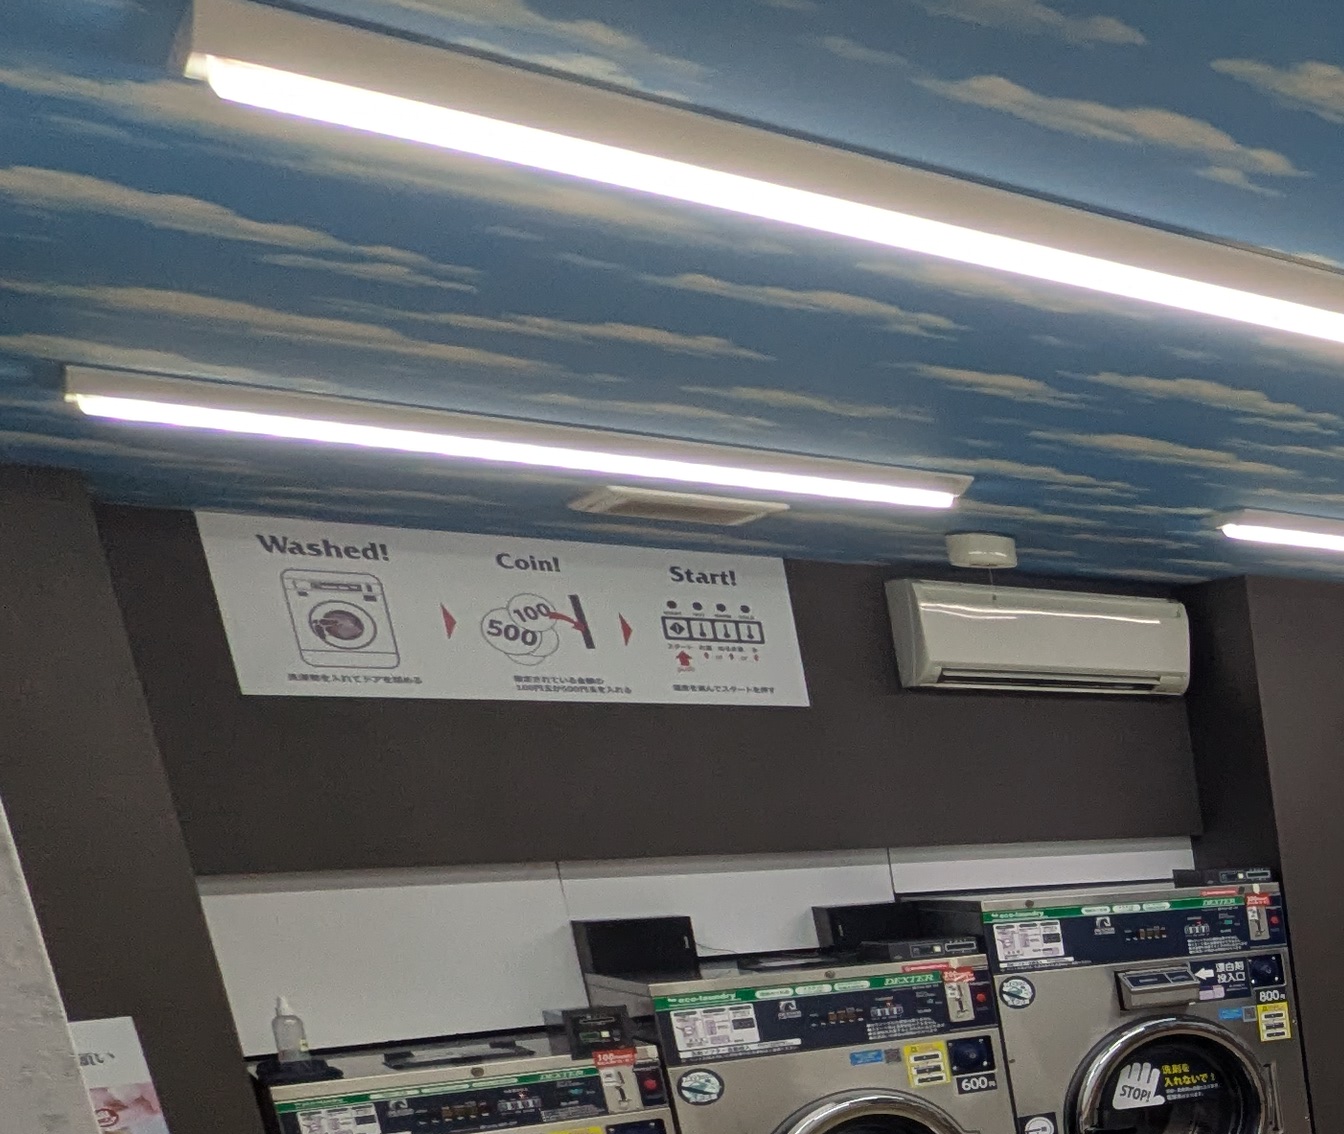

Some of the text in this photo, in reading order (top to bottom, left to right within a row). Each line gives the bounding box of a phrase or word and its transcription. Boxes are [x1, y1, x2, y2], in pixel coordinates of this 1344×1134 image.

[256, 534, 389, 561] Washed!
[496, 552, 561, 574] Coin!
[669, 565, 738, 586] Start!
[514, 603, 551, 623] 100
[487, 619, 538, 647] 500
[884, 973, 935, 986] DEXTER
[1162, 1063, 1190, 1074] 洗剤を
[961, 1077, 996, 1092] 600円
[1164, 1072, 1216, 1087] 入れないで！
[1120, 1085, 1151, 1102] STOP!
